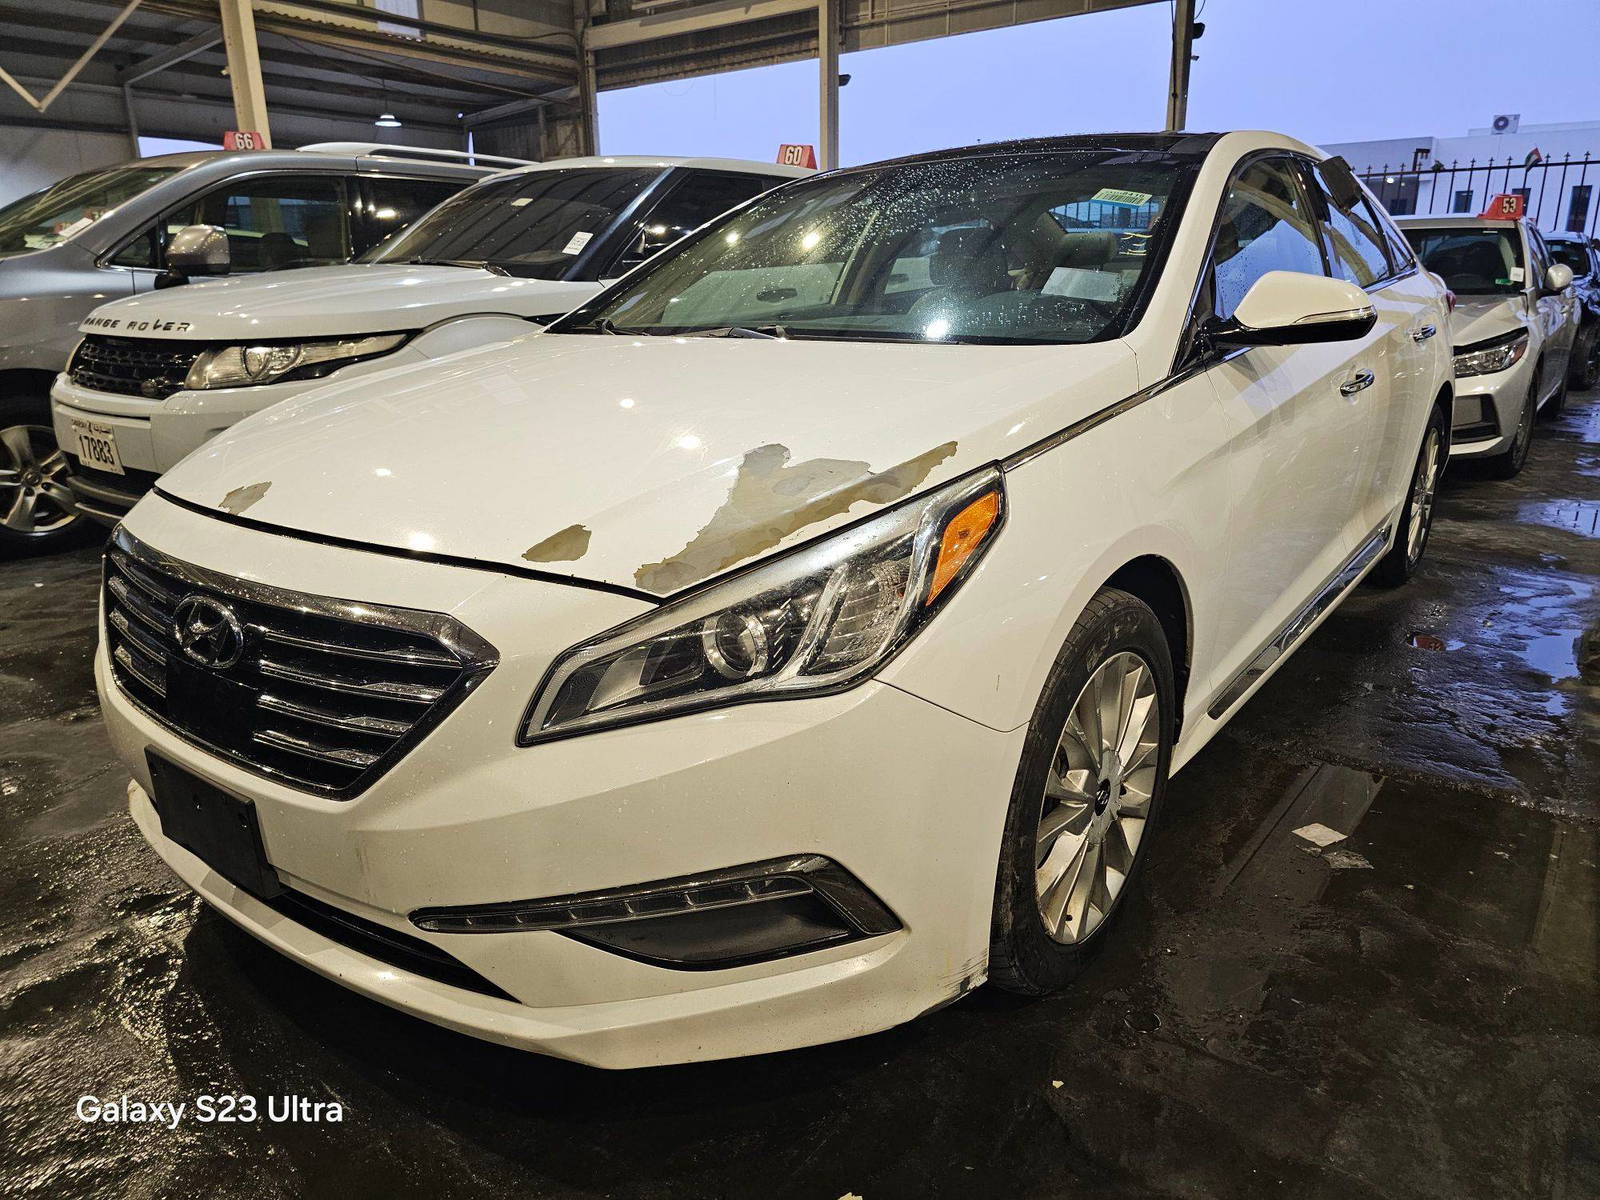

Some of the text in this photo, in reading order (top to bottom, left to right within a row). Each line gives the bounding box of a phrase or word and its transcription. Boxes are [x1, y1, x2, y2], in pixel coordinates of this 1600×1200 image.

[235, 133, 253, 149] 66
[785, 146, 803, 165] 60
[1503, 197, 1516, 213] 53
[83, 317, 121, 329] RANGE
[79, 433, 115, 465] 17883
